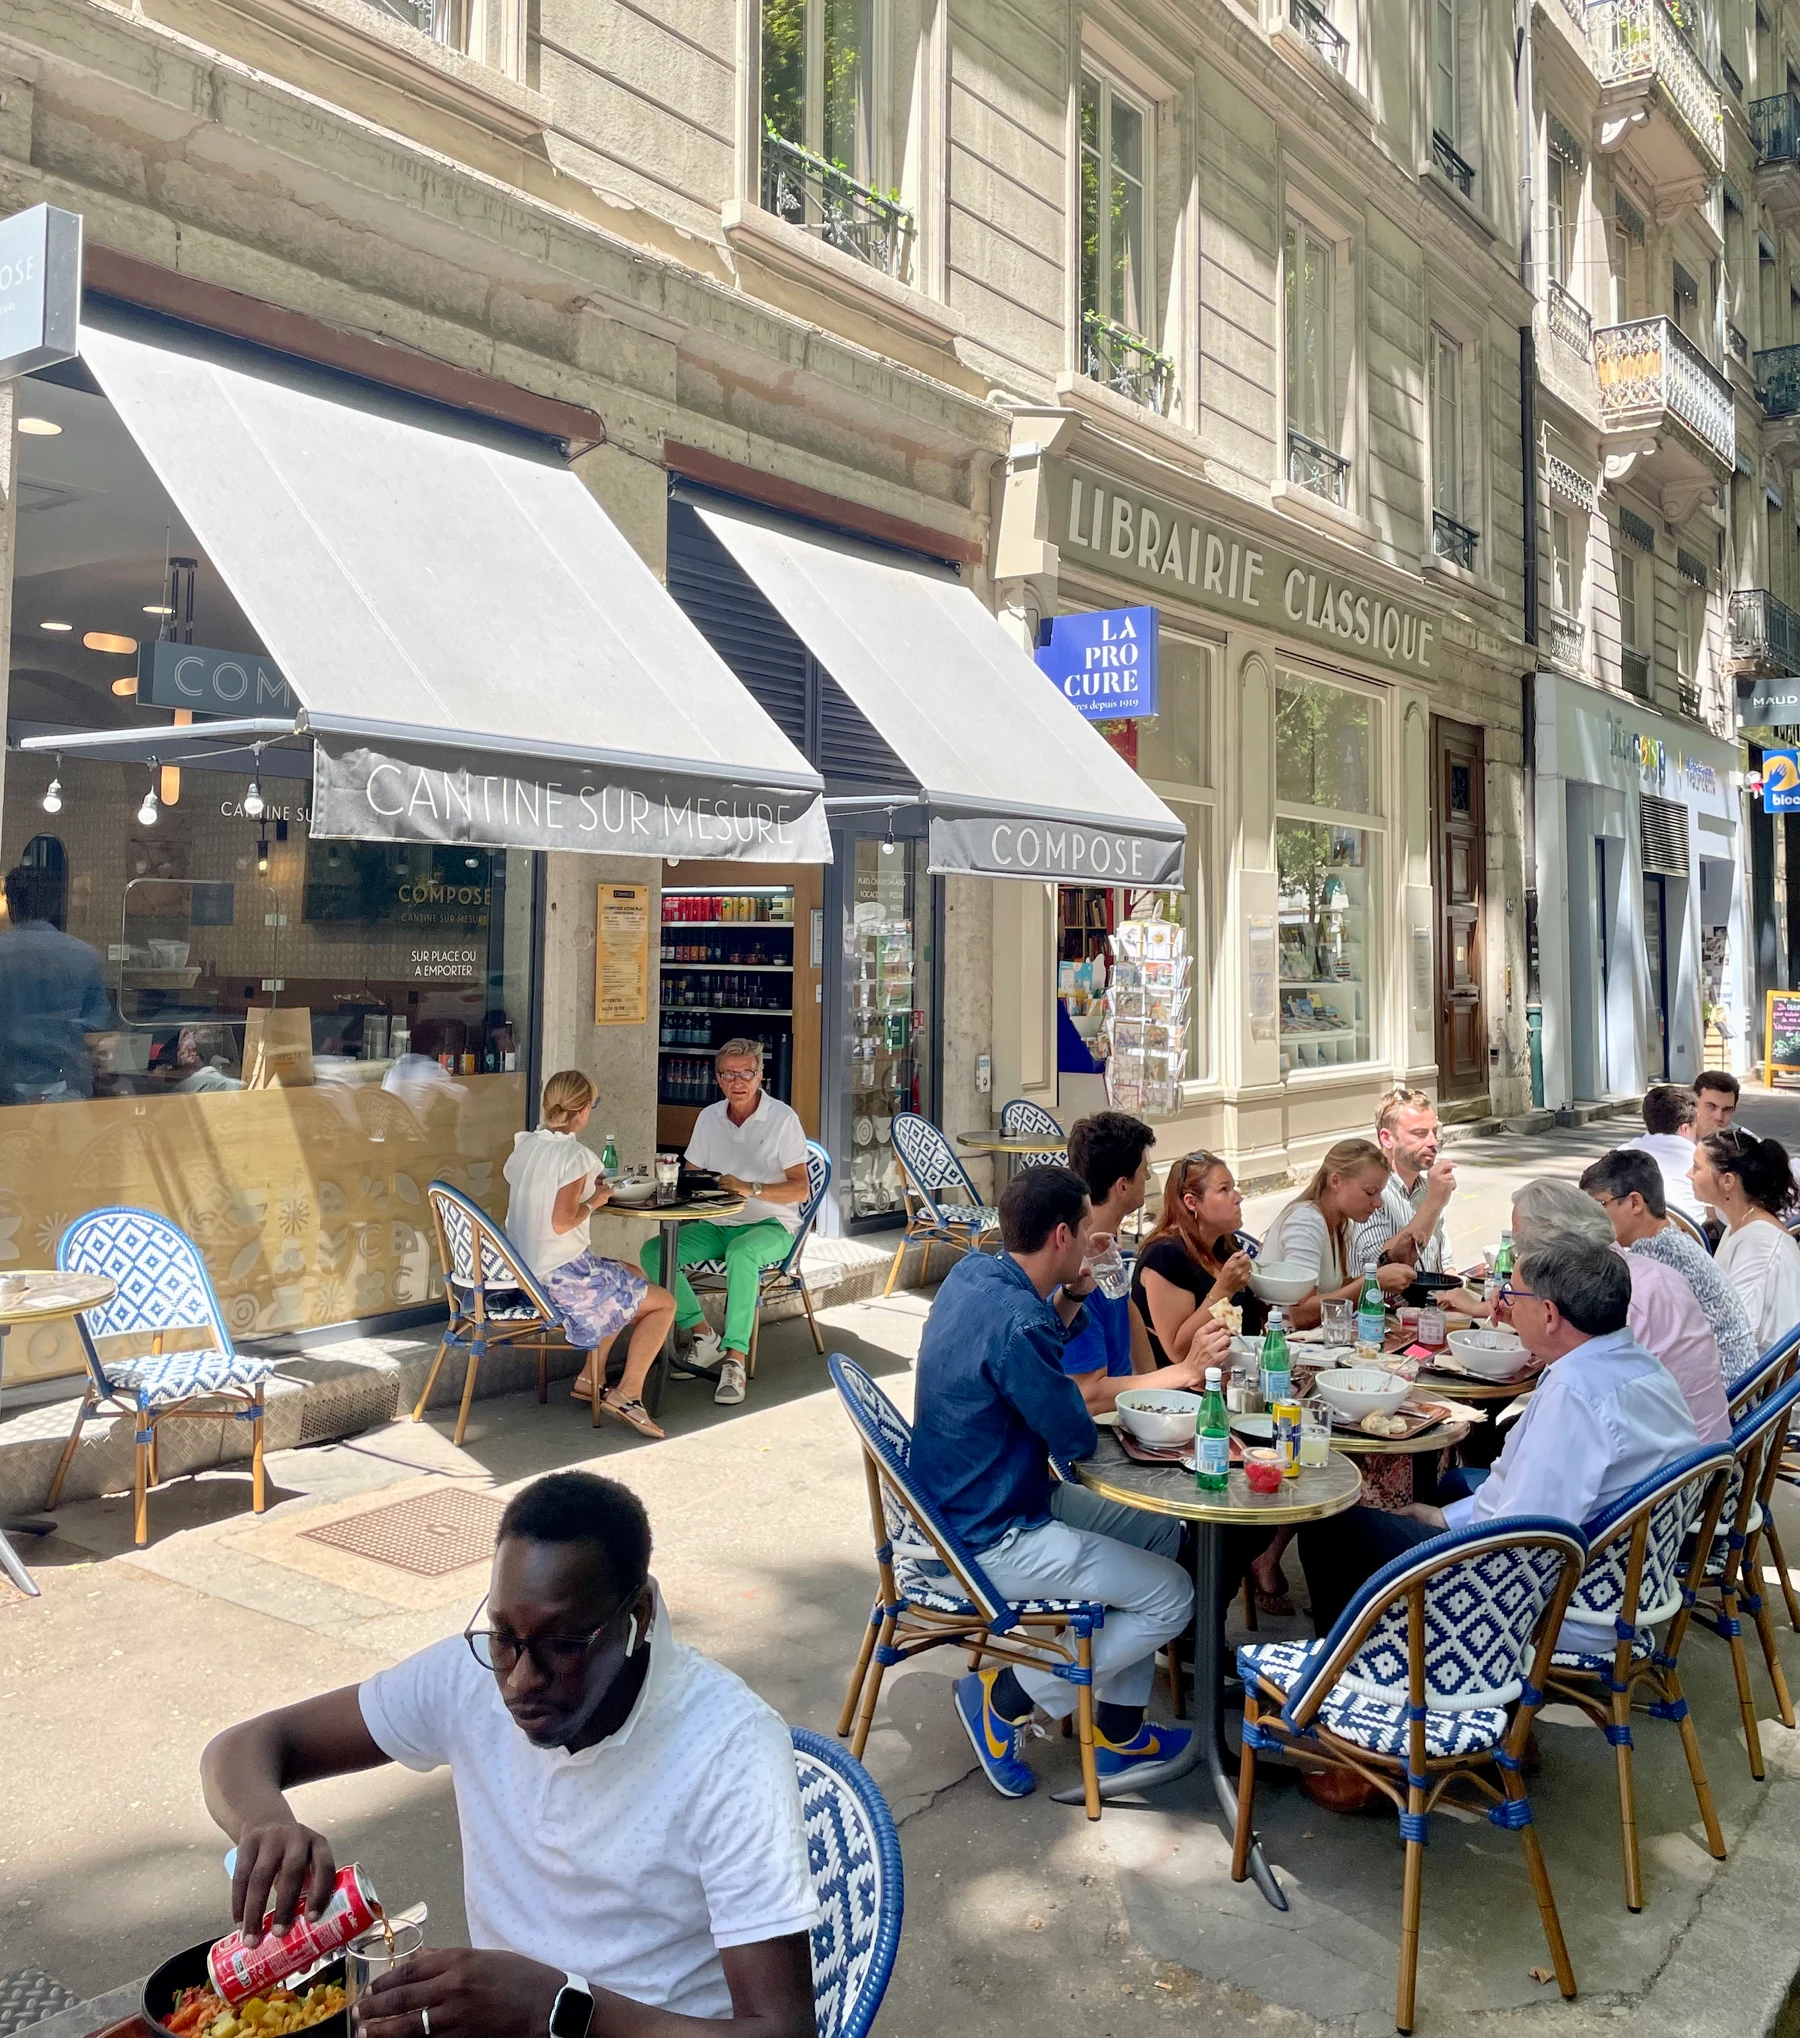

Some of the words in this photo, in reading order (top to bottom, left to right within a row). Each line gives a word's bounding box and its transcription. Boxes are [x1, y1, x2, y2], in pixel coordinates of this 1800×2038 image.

[1068, 478, 1264, 606] LIBRAIRIE
[1284, 568, 1434, 667] CLASSIQUE
[1102, 616, 1137, 641] LA
[1085, 643, 1138, 669] PRO
[1064, 670, 1138, 697] CURE
[1090, 697, 1117, 712] depuis
[1120, 699, 1139, 708] 1919
[1753, 695, 1798, 706] MAUD
[367, 764, 563, 829] CANTINE
[579, 786, 649, 836] SUR
[665, 794, 794, 844] MESURE
[992, 824, 1142, 876] COMPOSE
[858, 877, 870, 885] PLATS
[888, 878, 906, 886] SALADES
[398, 884, 491, 905] COMPOSE
[889, 891, 904, 899] PIZZAS
[401, 913, 437, 923] CANTINE
[440, 914, 455, 923] SUR
[411, 950, 429, 962] SUR
[431, 950, 459, 962] PLACE
[461, 950, 477, 962] OU
[414, 965, 422, 977] A
[424, 965, 472, 977] EMPORTER
